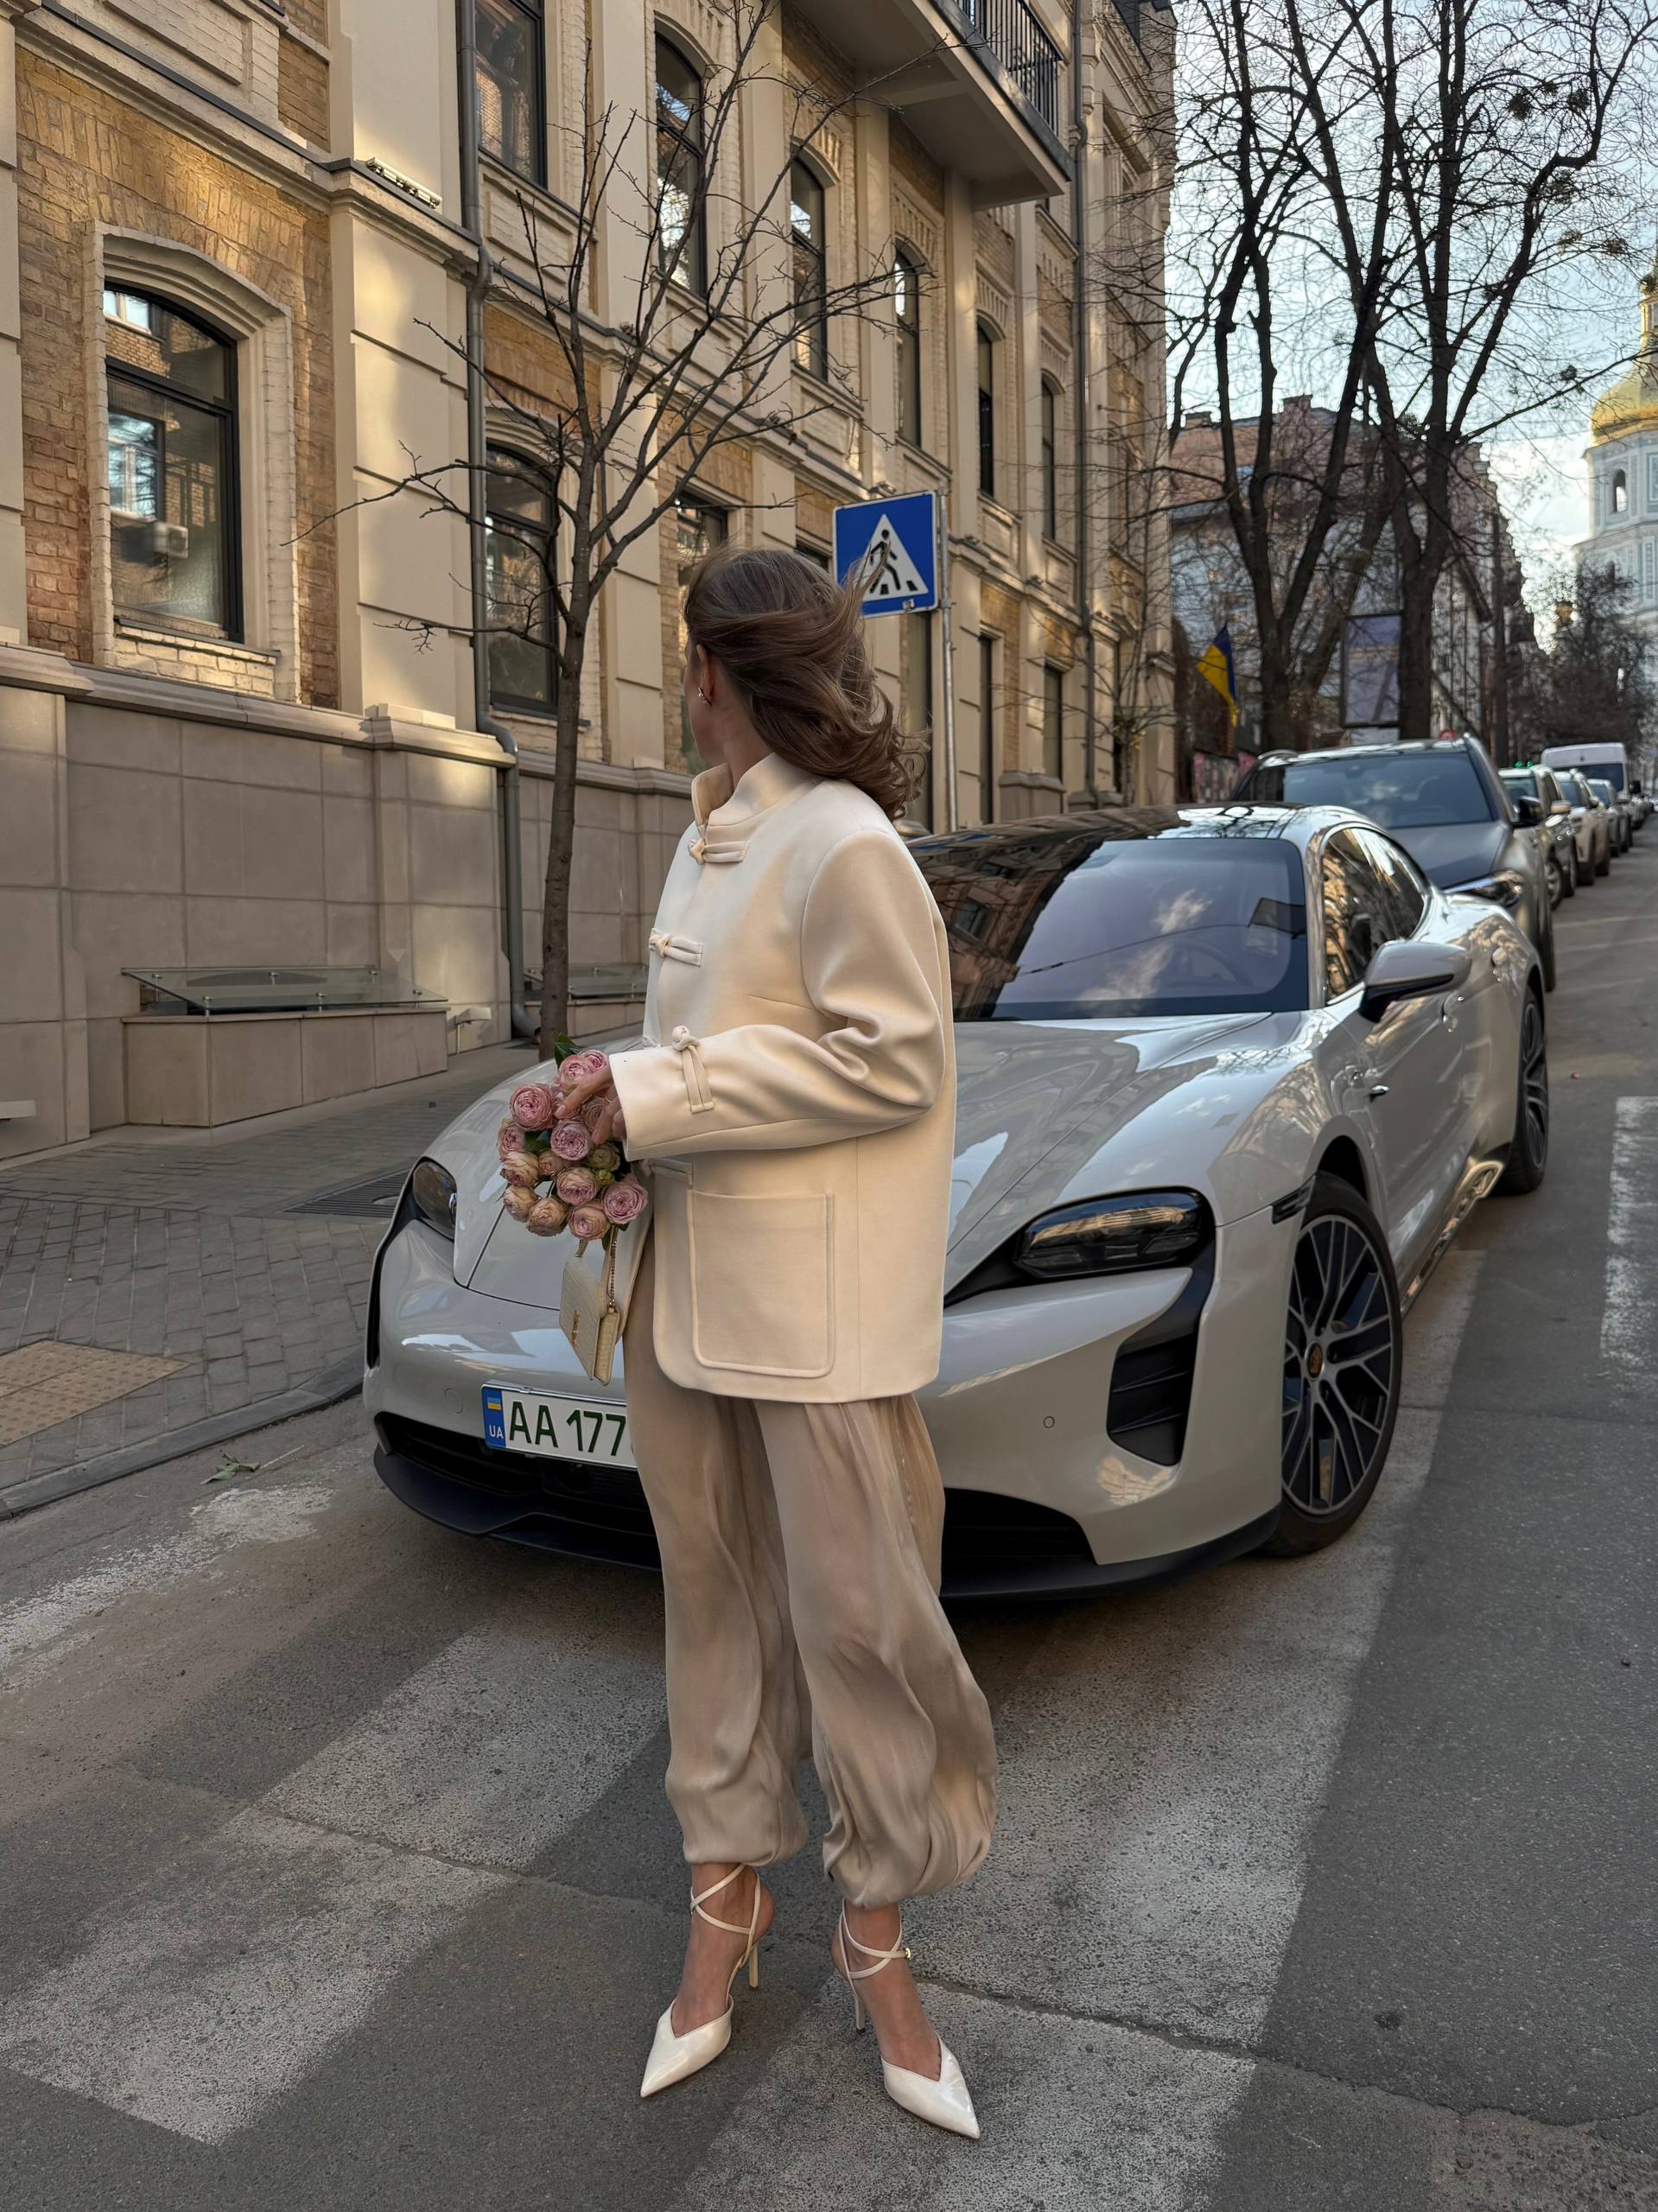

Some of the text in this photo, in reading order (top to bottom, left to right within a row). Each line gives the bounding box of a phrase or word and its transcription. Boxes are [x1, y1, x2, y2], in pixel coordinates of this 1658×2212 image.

[489, 1425, 504, 1439] UA
[509, 1401, 634, 1456] AA 177
